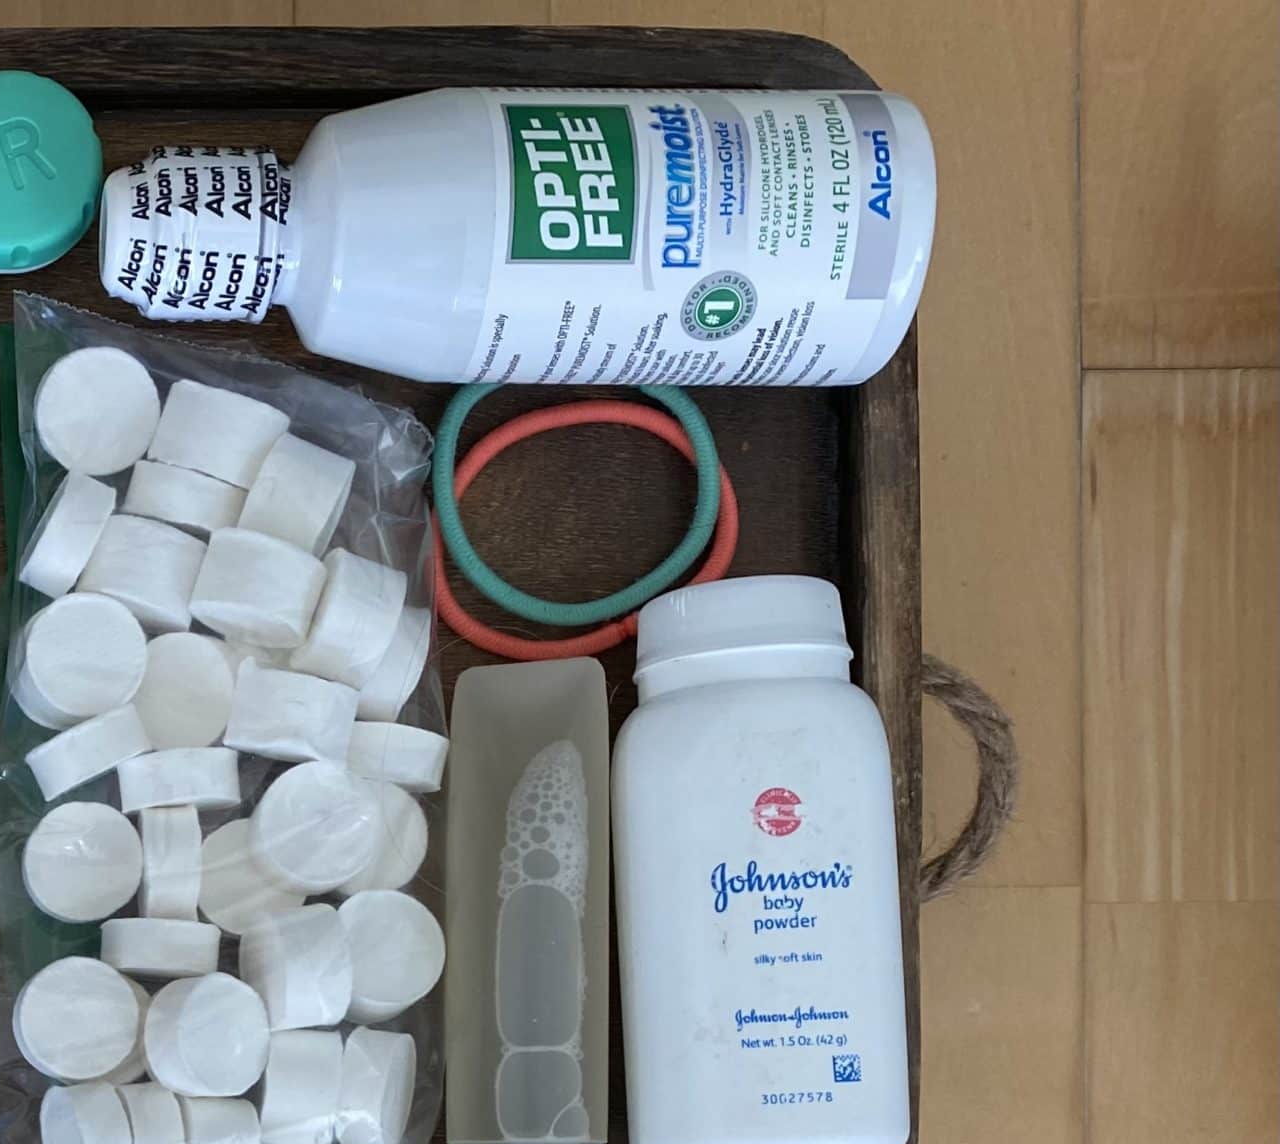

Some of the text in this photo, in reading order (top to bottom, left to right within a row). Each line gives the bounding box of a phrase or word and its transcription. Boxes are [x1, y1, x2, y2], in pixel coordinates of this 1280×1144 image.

[827, 117, 852, 145] (120
[520, 118, 580, 250] OPTI-
[560, 117, 623, 247] FREE
[648, 104, 701, 268] puremoist
[696, 136, 708, 190] DISINFECTING
[715, 121, 736, 216] HydraGlyde
[754, 115, 770, 250] FOR SILICONE HYDROGEL
[764, 109, 783, 257] AND SOFT CONTACT LENSES
[784, 129, 799, 238] CLEANS RINSES
[795, 113, 814, 248] DISINFECTS STORES
[831, 149, 850, 171] OZ
[833, 176, 851, 197] FL
[867, 130, 892, 220] Alcon
[131, 182, 150, 220] Alcon
[155, 168, 172, 217] Alcon
[178, 167, 199, 216] Alcon
[204, 166, 225, 218] Alcon
[231, 166, 252, 220] Alcon
[260, 163, 278, 221] Alcon
[833, 201, 849, 213] 4
[696, 192, 708, 257] MULTI-PURPOSE
[831, 221, 848, 280] STERILE
[118, 238, 147, 290] Alcon
[141, 243, 168, 305] Alcon
[162, 247, 192, 308] Alcon
[188, 250, 219, 310] Alcon
[214, 253, 247, 311] Alcon
[241, 256, 273, 313] Alcon
[684, 284, 707, 332] DOCTOR
[704, 301, 735, 325] #1
[711, 860, 852, 913] Johnson's
[763, 895, 804, 912] baby
[753, 913, 817, 934] powder
[754, 953, 776, 966] silky
[801, 951, 823, 962] skin
[741, 1038, 760, 1048] Net
[816, 1035, 833, 1046] (42
[836, 1034, 848, 1047] g)
